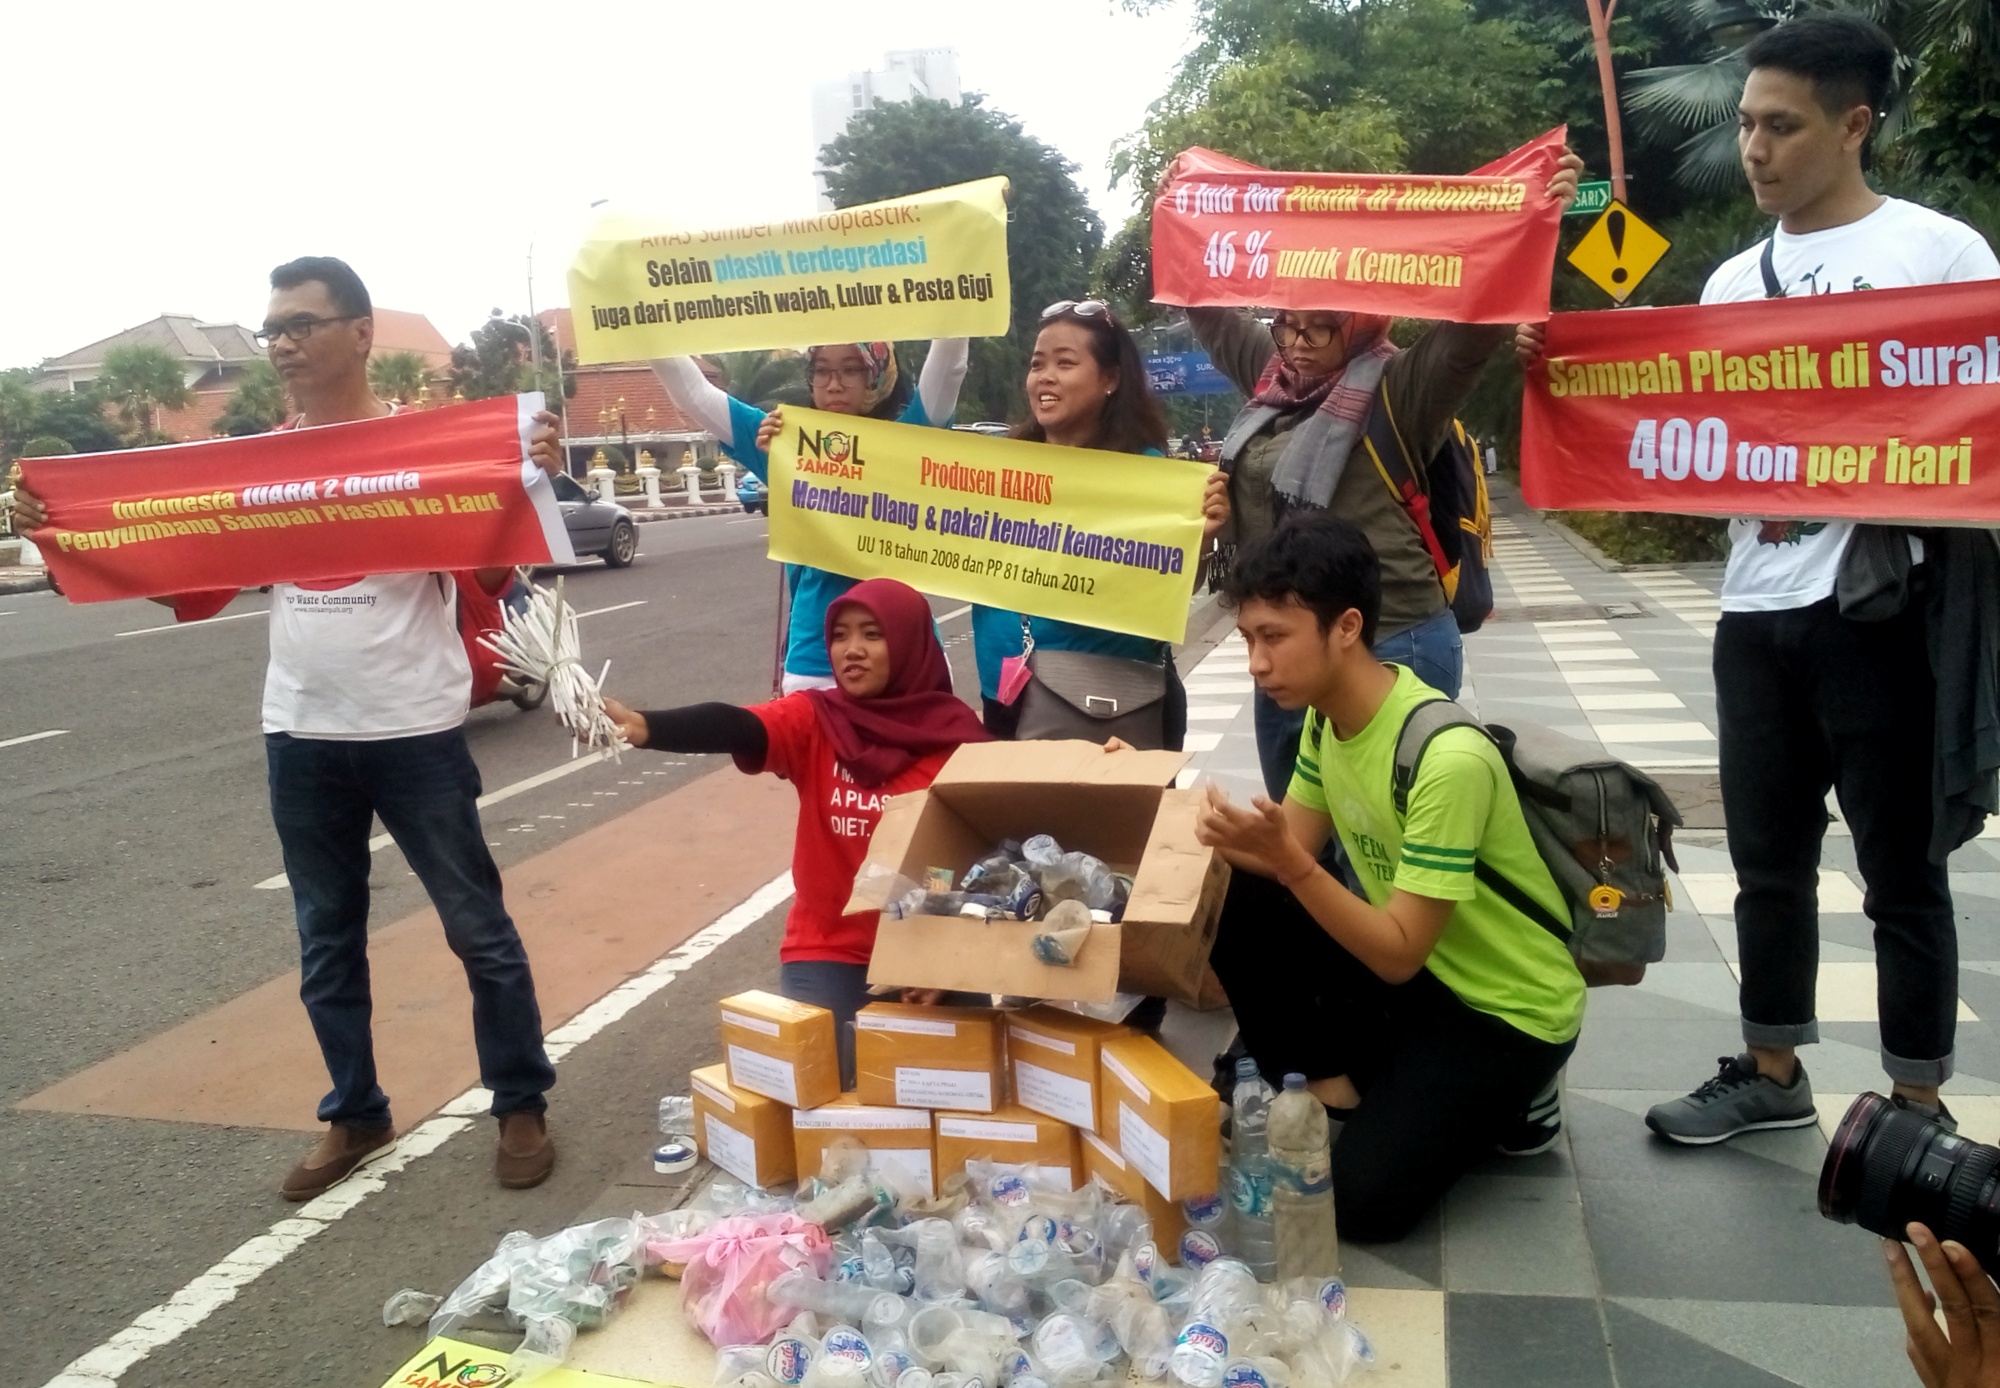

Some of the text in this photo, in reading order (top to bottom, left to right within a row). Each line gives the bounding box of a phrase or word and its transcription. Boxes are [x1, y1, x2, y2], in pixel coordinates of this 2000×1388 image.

[1192, 182, 1239, 218] Juta
[1243, 182, 1285, 213] Ton
[1285, 184, 1366, 212] Plastik
[1367, 181, 1396, 212] di
[1396, 177, 1527, 212] Indonesia
[646, 236, 928, 289] Selain plastik terdegradasi
[1203, 230, 1463, 287] 46 % untuk Kemasan
[591, 272, 994, 331] juga dari pembersih wajah, Lulur & Pasta Gigi
[1547, 352, 1683, 399] Sampah
[1689, 344, 1823, 393] Plastik
[1830, 342, 1870, 389] di
[795, 457, 863, 481] SAMPAH
[1627, 416, 1972, 487] 400 ton per hari
[112, 470, 421, 520] Indonesia JUARA 2 Dunia
[920, 455, 1054, 505] Produsen HARUS
[56, 491, 503, 553] Penyumbang Sampah Plastik ke Laut
[790, 479, 1184, 576] Mendaur Ulang & pakai kembali kemasannya
[856, 533, 1095, 597] UU 18 tahun 2008 dan PP 81 tahun 2012
[296, 594, 319, 605] Waste
[322, 593, 377, 607] Community
[830, 787, 842, 807] A
[831, 815, 871, 837] DIET.
[1347, 828, 1391, 863] REEN
